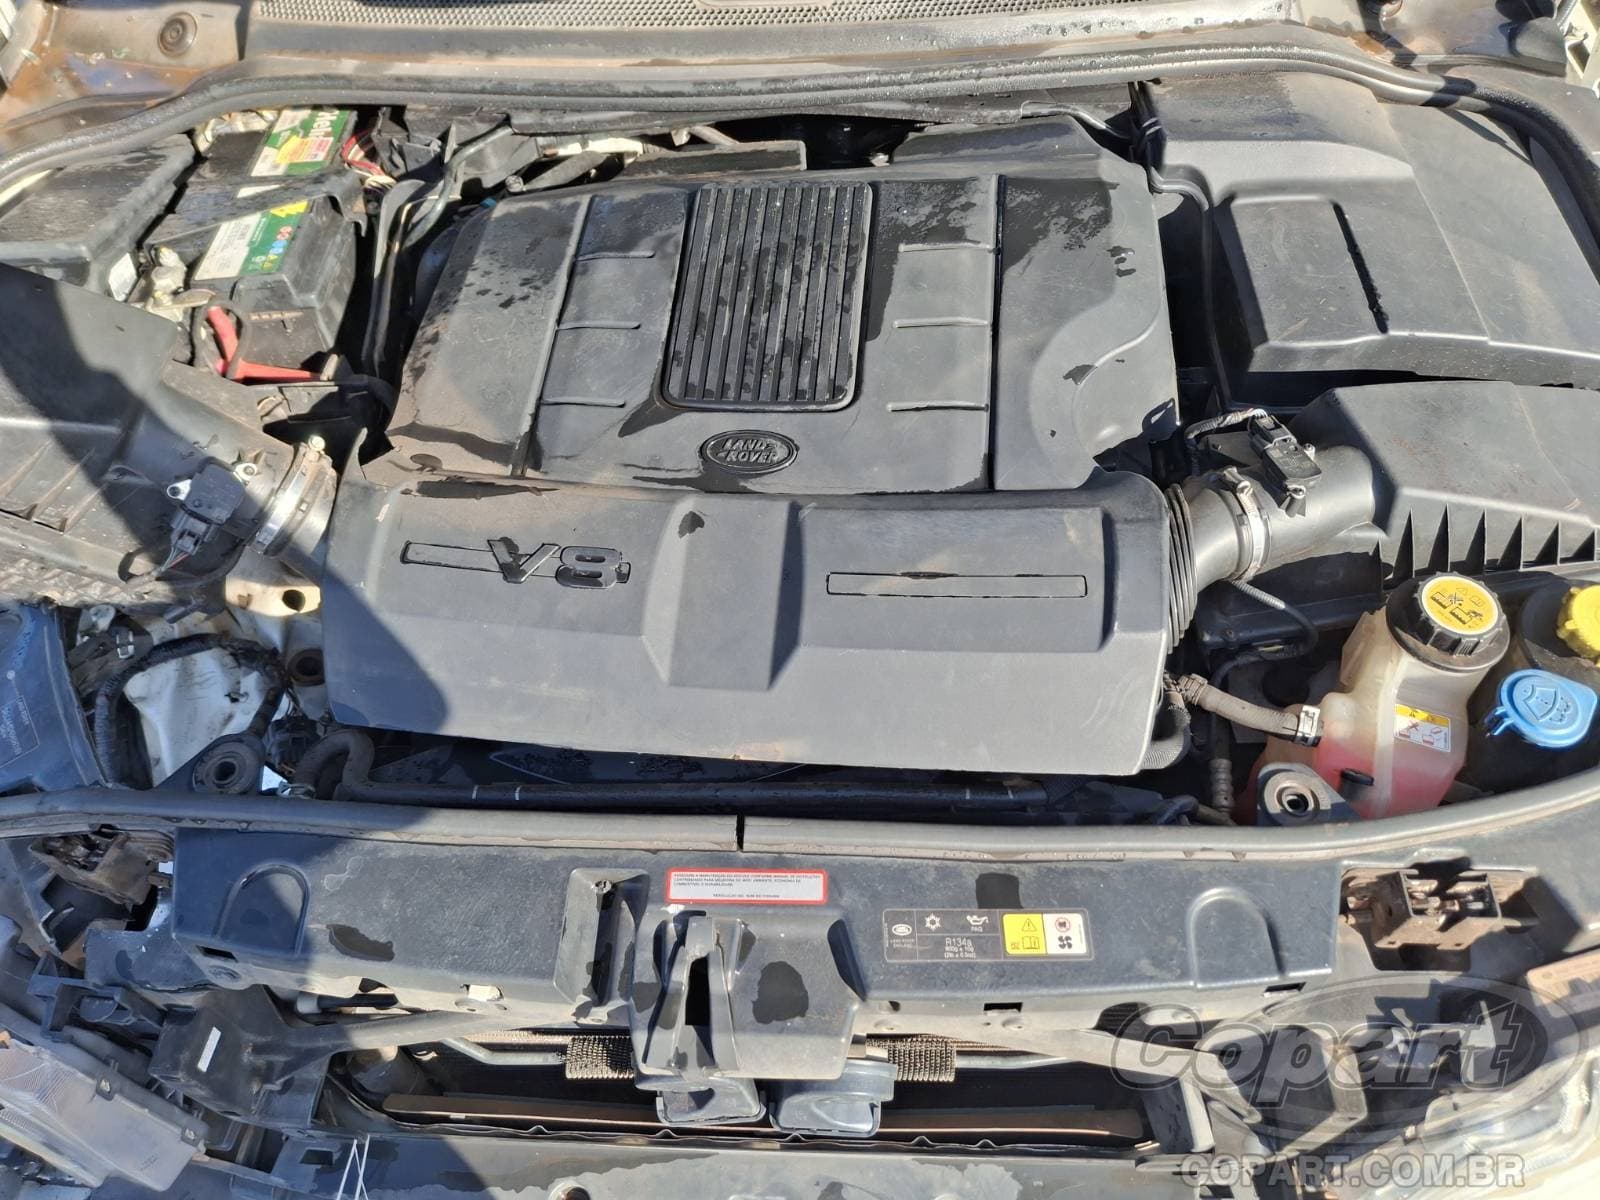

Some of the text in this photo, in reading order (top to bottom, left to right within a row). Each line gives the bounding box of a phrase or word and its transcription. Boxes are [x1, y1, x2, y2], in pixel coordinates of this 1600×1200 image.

[722, 438, 770, 452] LAND
[726, 450, 779, 463] ROVER
[487, 536, 622, 590] V8
[945, 937, 972, 947] R134a
